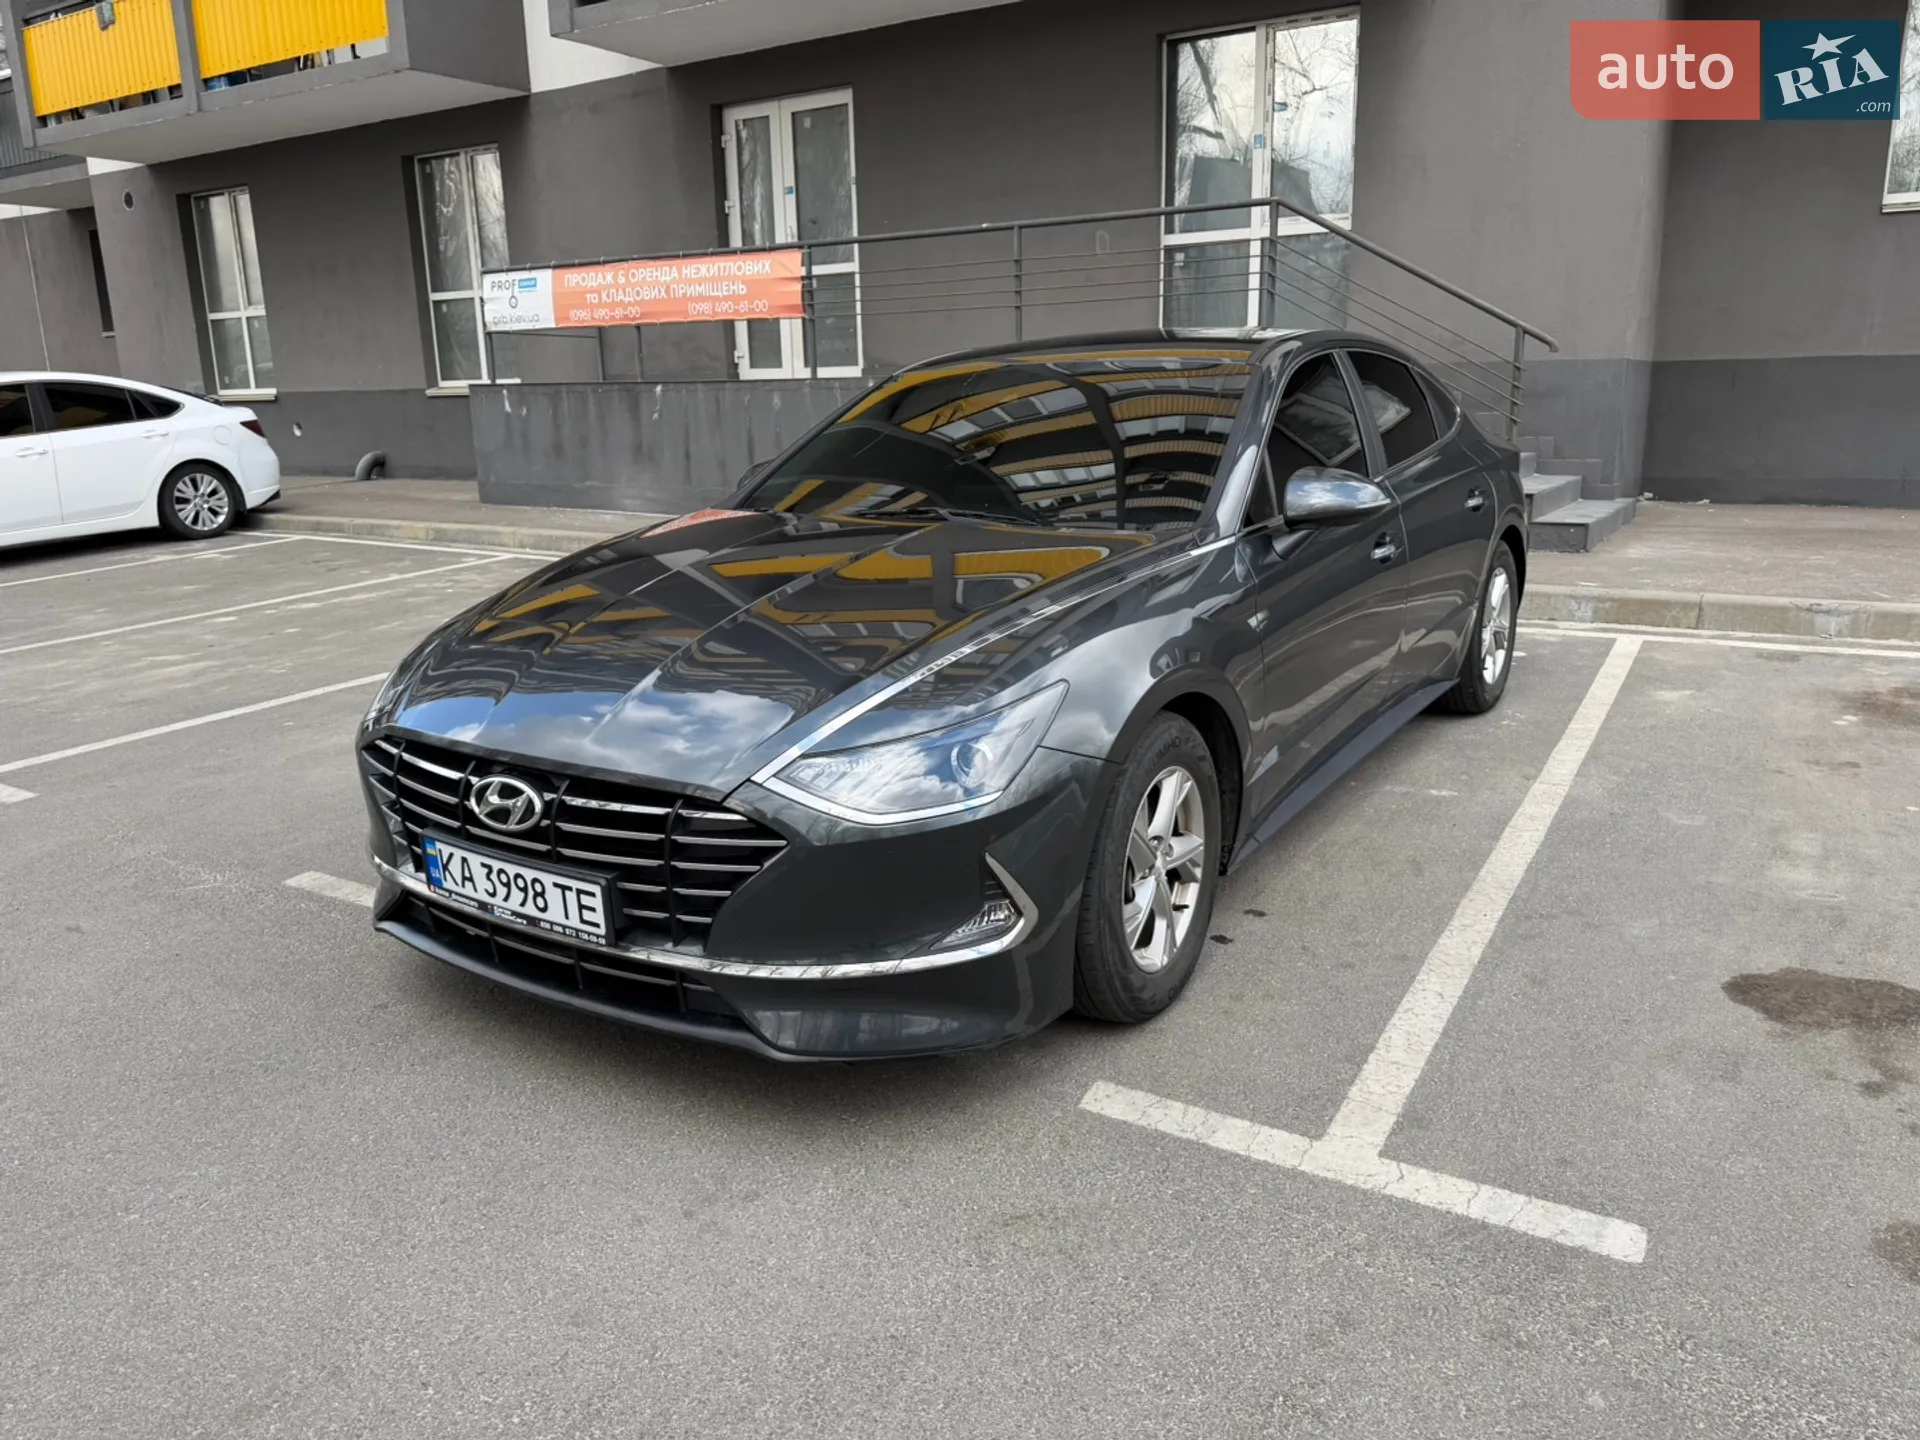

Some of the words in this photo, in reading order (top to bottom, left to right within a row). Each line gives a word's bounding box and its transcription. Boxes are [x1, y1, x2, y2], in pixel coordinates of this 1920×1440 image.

[564, 270, 613, 288] ПРОДАЖ
[629, 266, 679, 283] ОРЕНДА
[682, 259, 772, 279] НЕЖИТЛОВИХ
[585, 293, 599, 304] та
[602, 284, 668, 304] КЛАДОВИХ
[670, 279, 748, 298] ПРИМІЩЕНЬ
[593, 306, 641, 319] 490-61-00
[714, 299, 769, 314] 490-61-00
[439, 848, 478, 893] KA
[480, 861, 549, 914] 3998
[552, 881, 602, 930] TE
